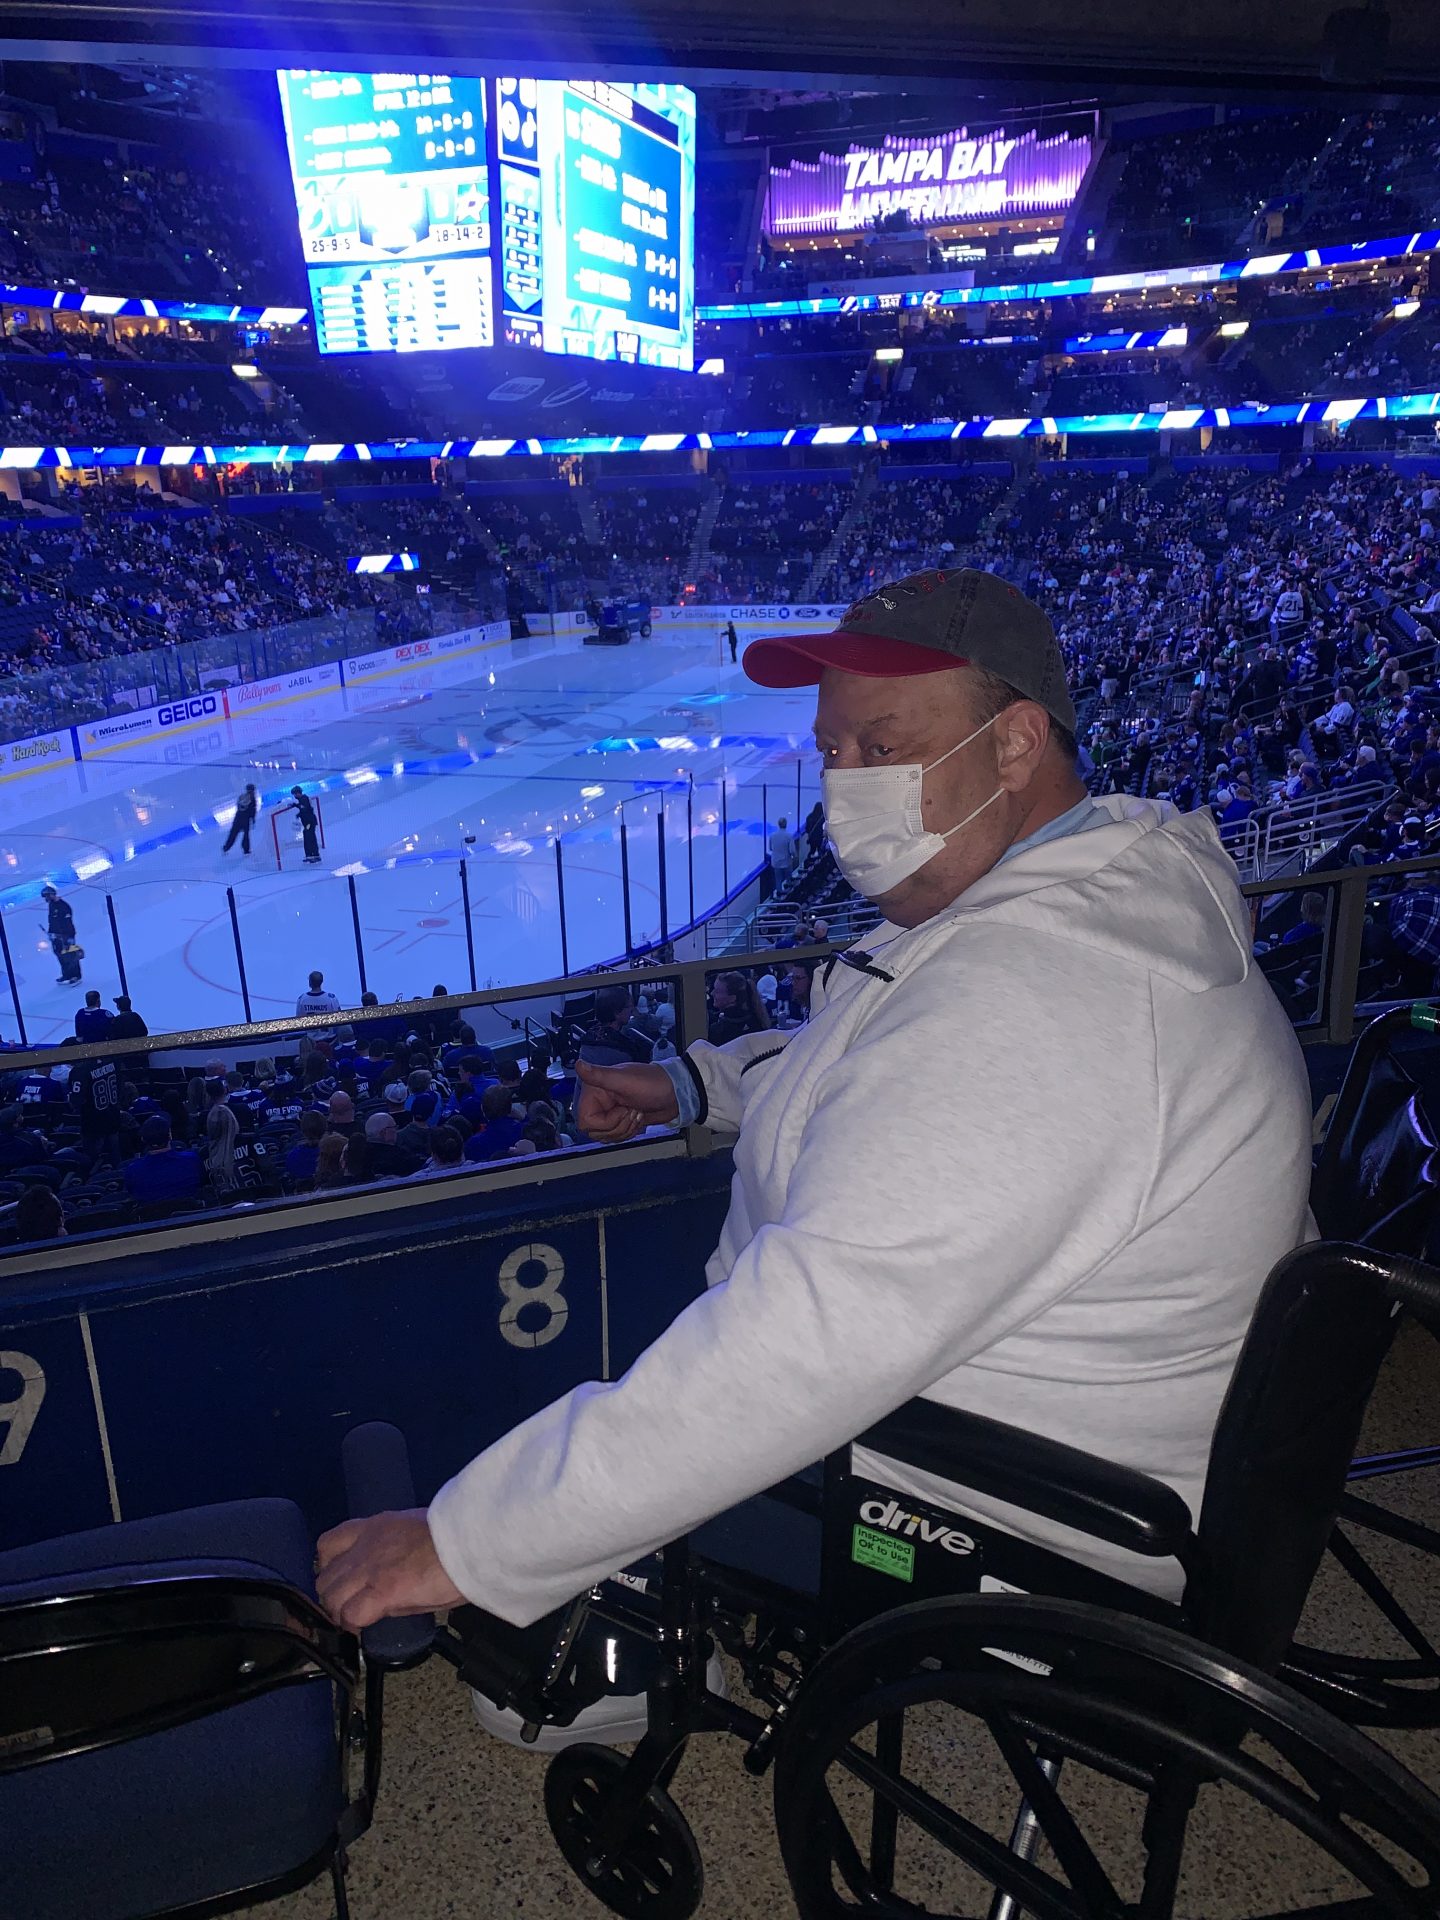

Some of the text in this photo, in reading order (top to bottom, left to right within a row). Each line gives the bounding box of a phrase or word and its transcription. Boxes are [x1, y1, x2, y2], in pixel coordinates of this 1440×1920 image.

[844, 139, 1016, 190] TAMPA BAY
[312, 238, 351, 252] 25-9-5
[730, 608, 776, 619] CHASE
[396, 646, 411, 659] DEX
[414, 641, 430, 654] DEX
[238, 685, 262, 703] Bally
[288, 675, 312, 688] JABIL
[158, 696, 216, 726] GEICO
[99, 718, 152, 736] MicroLumen
[12, 741, 36, 761] Hard
[37, 736, 61, 757] Rock
[92, 1074, 118, 1110] 86
[499, 1243, 568, 1349] 8
[0, 1350, 46, 1465] 9
[859, 1500, 975, 1555] drive
[858, 1528, 911, 1555] Inspected
[858, 1539, 874, 1550] OK
[877, 1546, 888, 1555] to
[891, 1551, 909, 1564] Use
